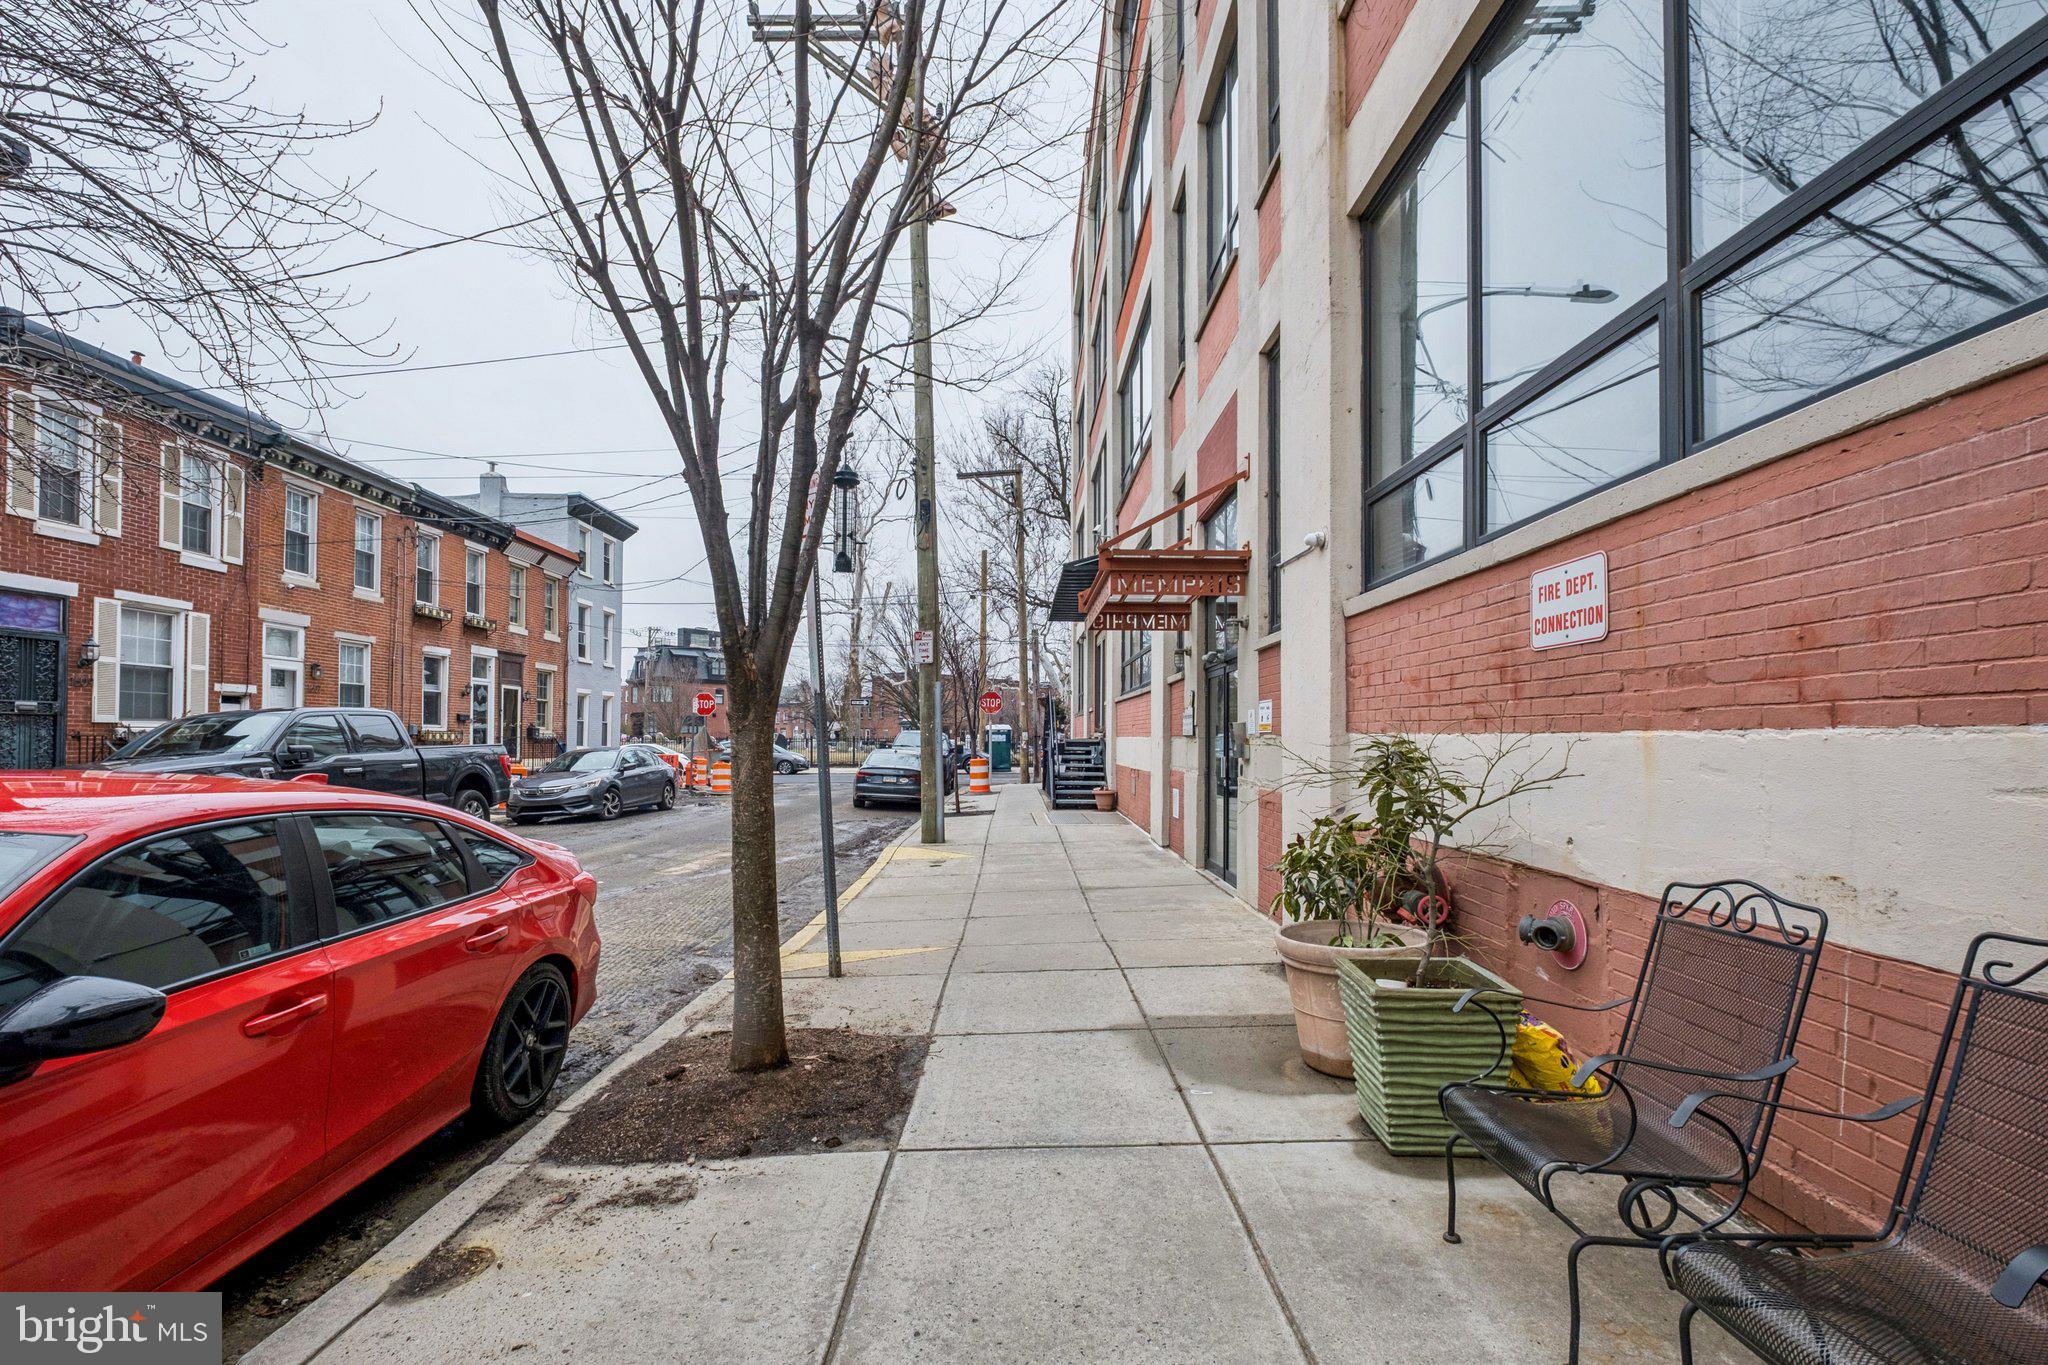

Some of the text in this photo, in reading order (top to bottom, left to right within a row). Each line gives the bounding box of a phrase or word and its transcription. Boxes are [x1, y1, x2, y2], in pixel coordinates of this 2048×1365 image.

[1538, 572, 1597, 604] FIRE DEPT.
[1534, 604, 1603, 636] CONNECTION
[981, 698, 1001, 708] STOP
